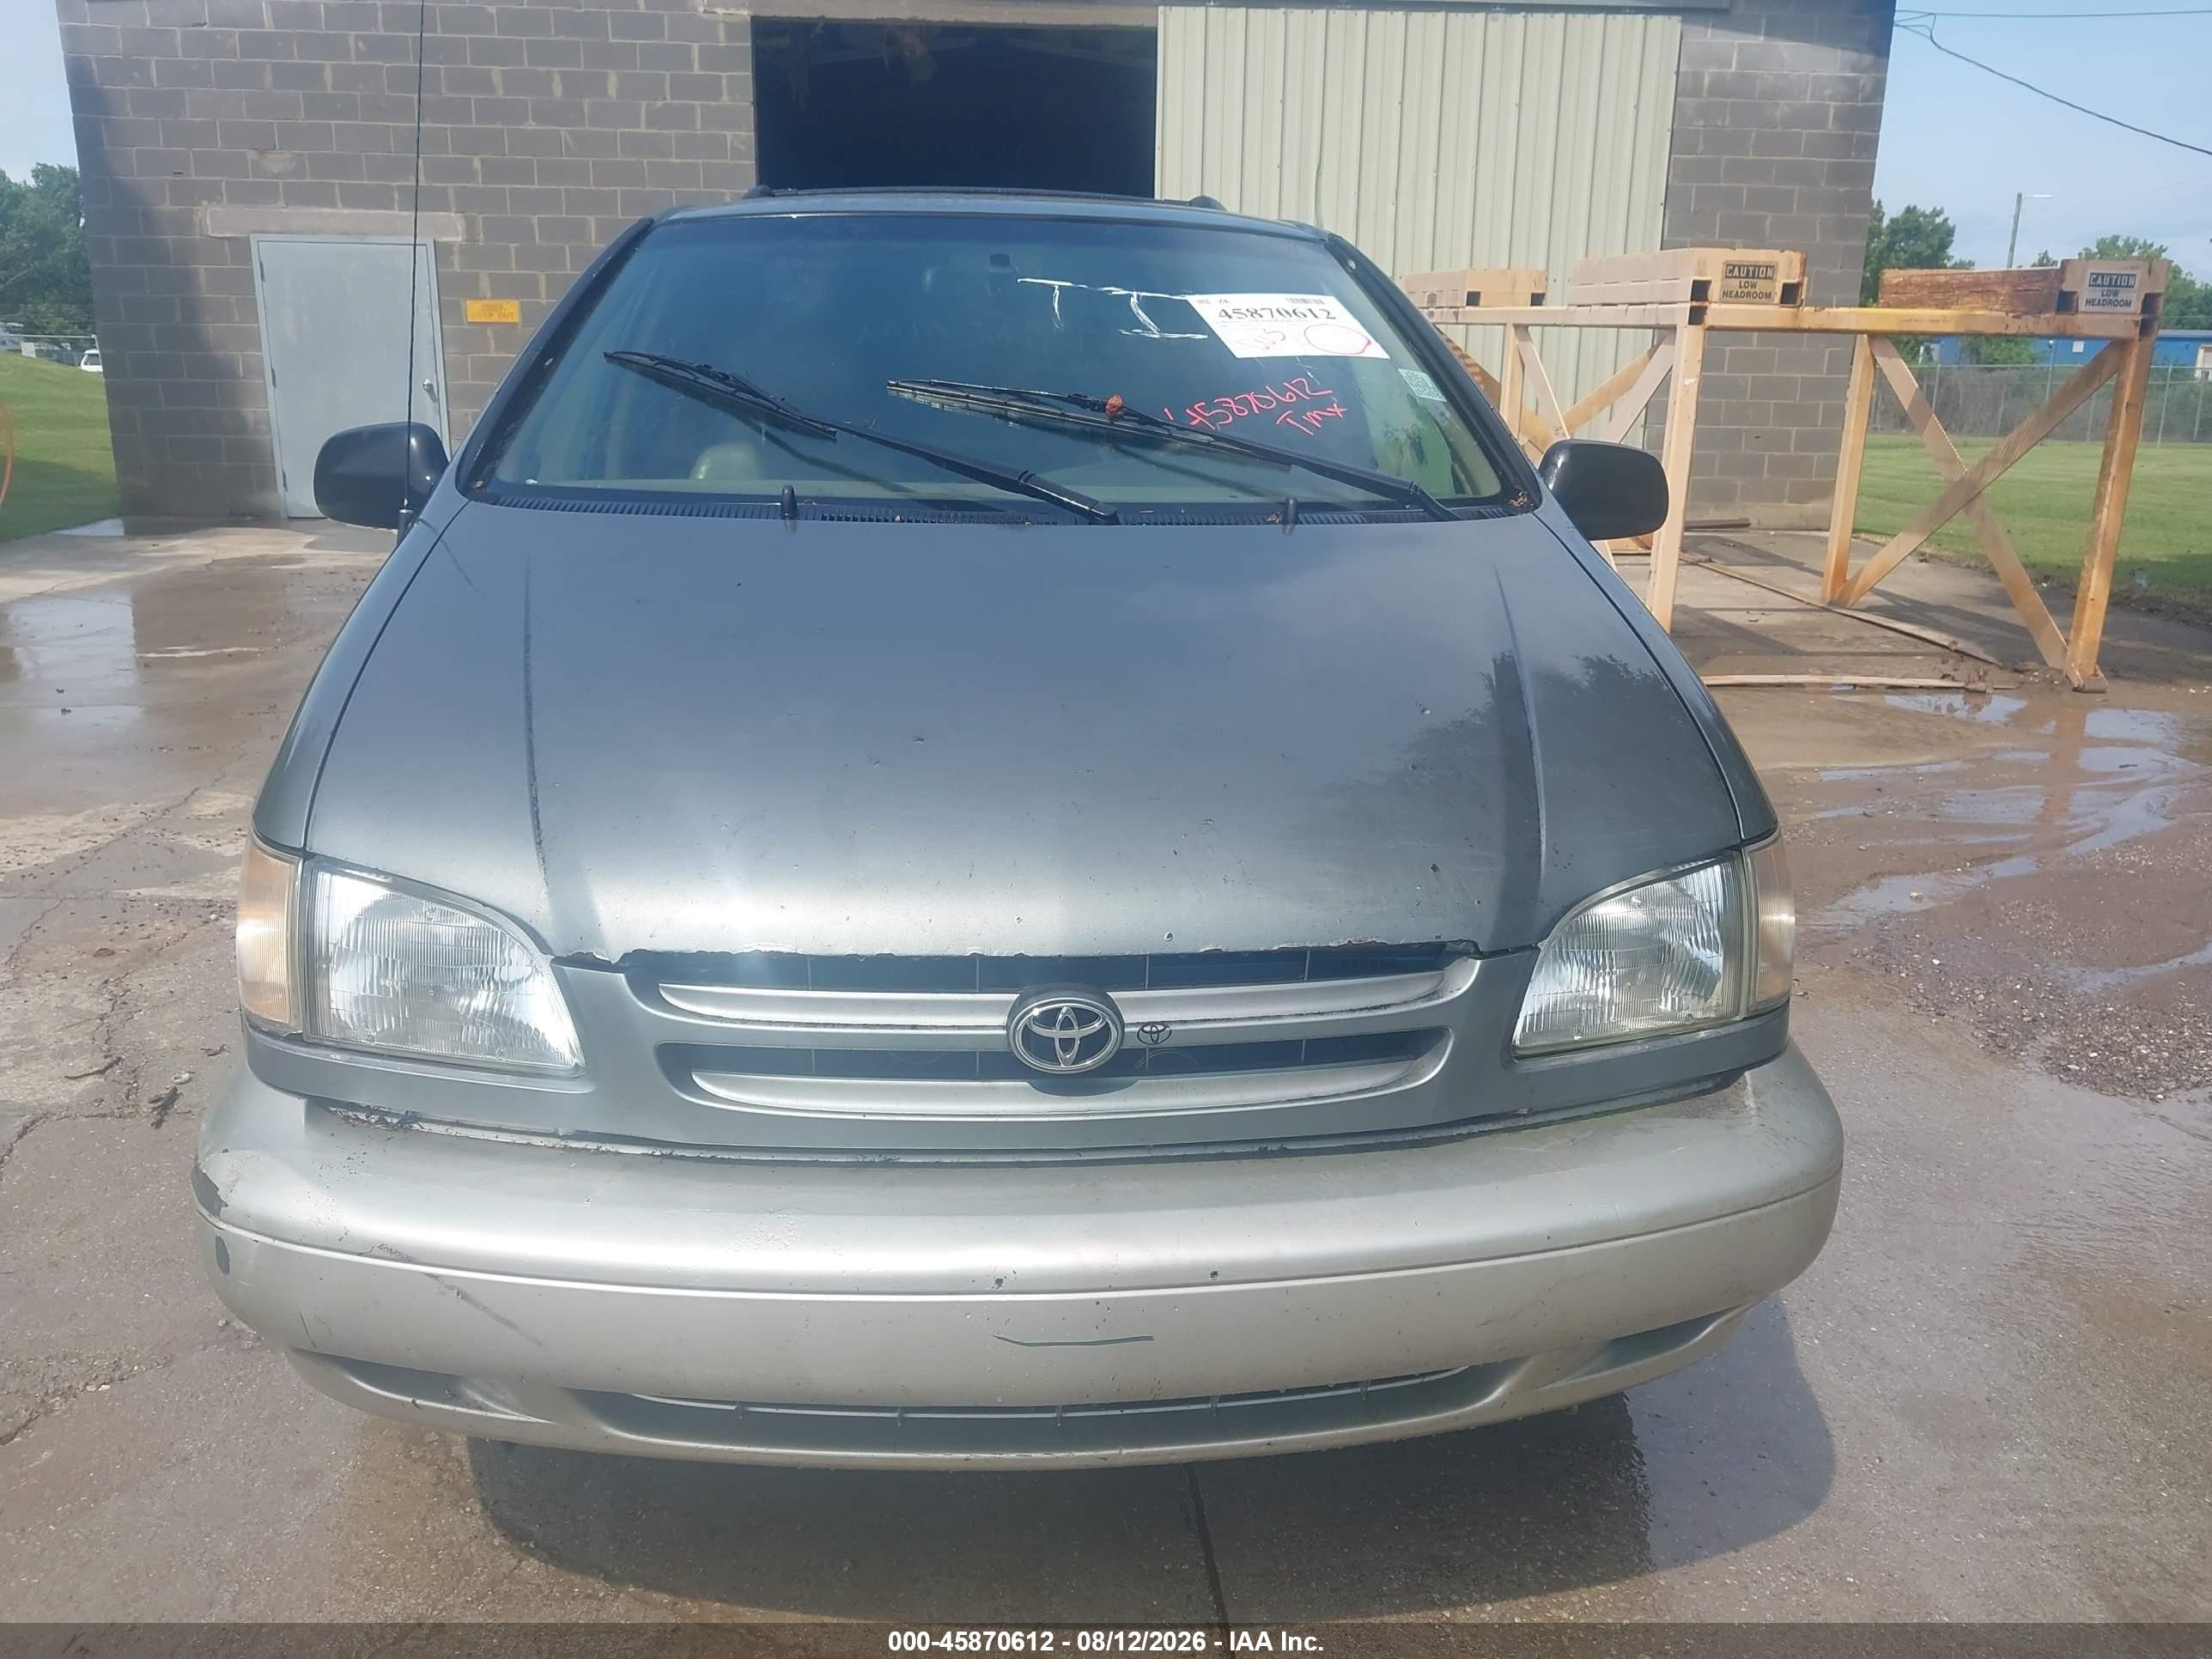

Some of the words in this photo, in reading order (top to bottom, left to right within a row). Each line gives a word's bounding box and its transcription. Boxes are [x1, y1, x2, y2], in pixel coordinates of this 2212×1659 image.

[1726, 265, 1774, 278] CAUTION
[1738, 281, 1758, 289] LOW
[2089, 275, 2136, 287] CAUTION
[1722, 290, 1771, 300] HEADROOM
[2100, 289, 2119, 297] LOW
[2085, 298, 2132, 307] HEADROOM
[1218, 307, 1337, 320] 45870612
